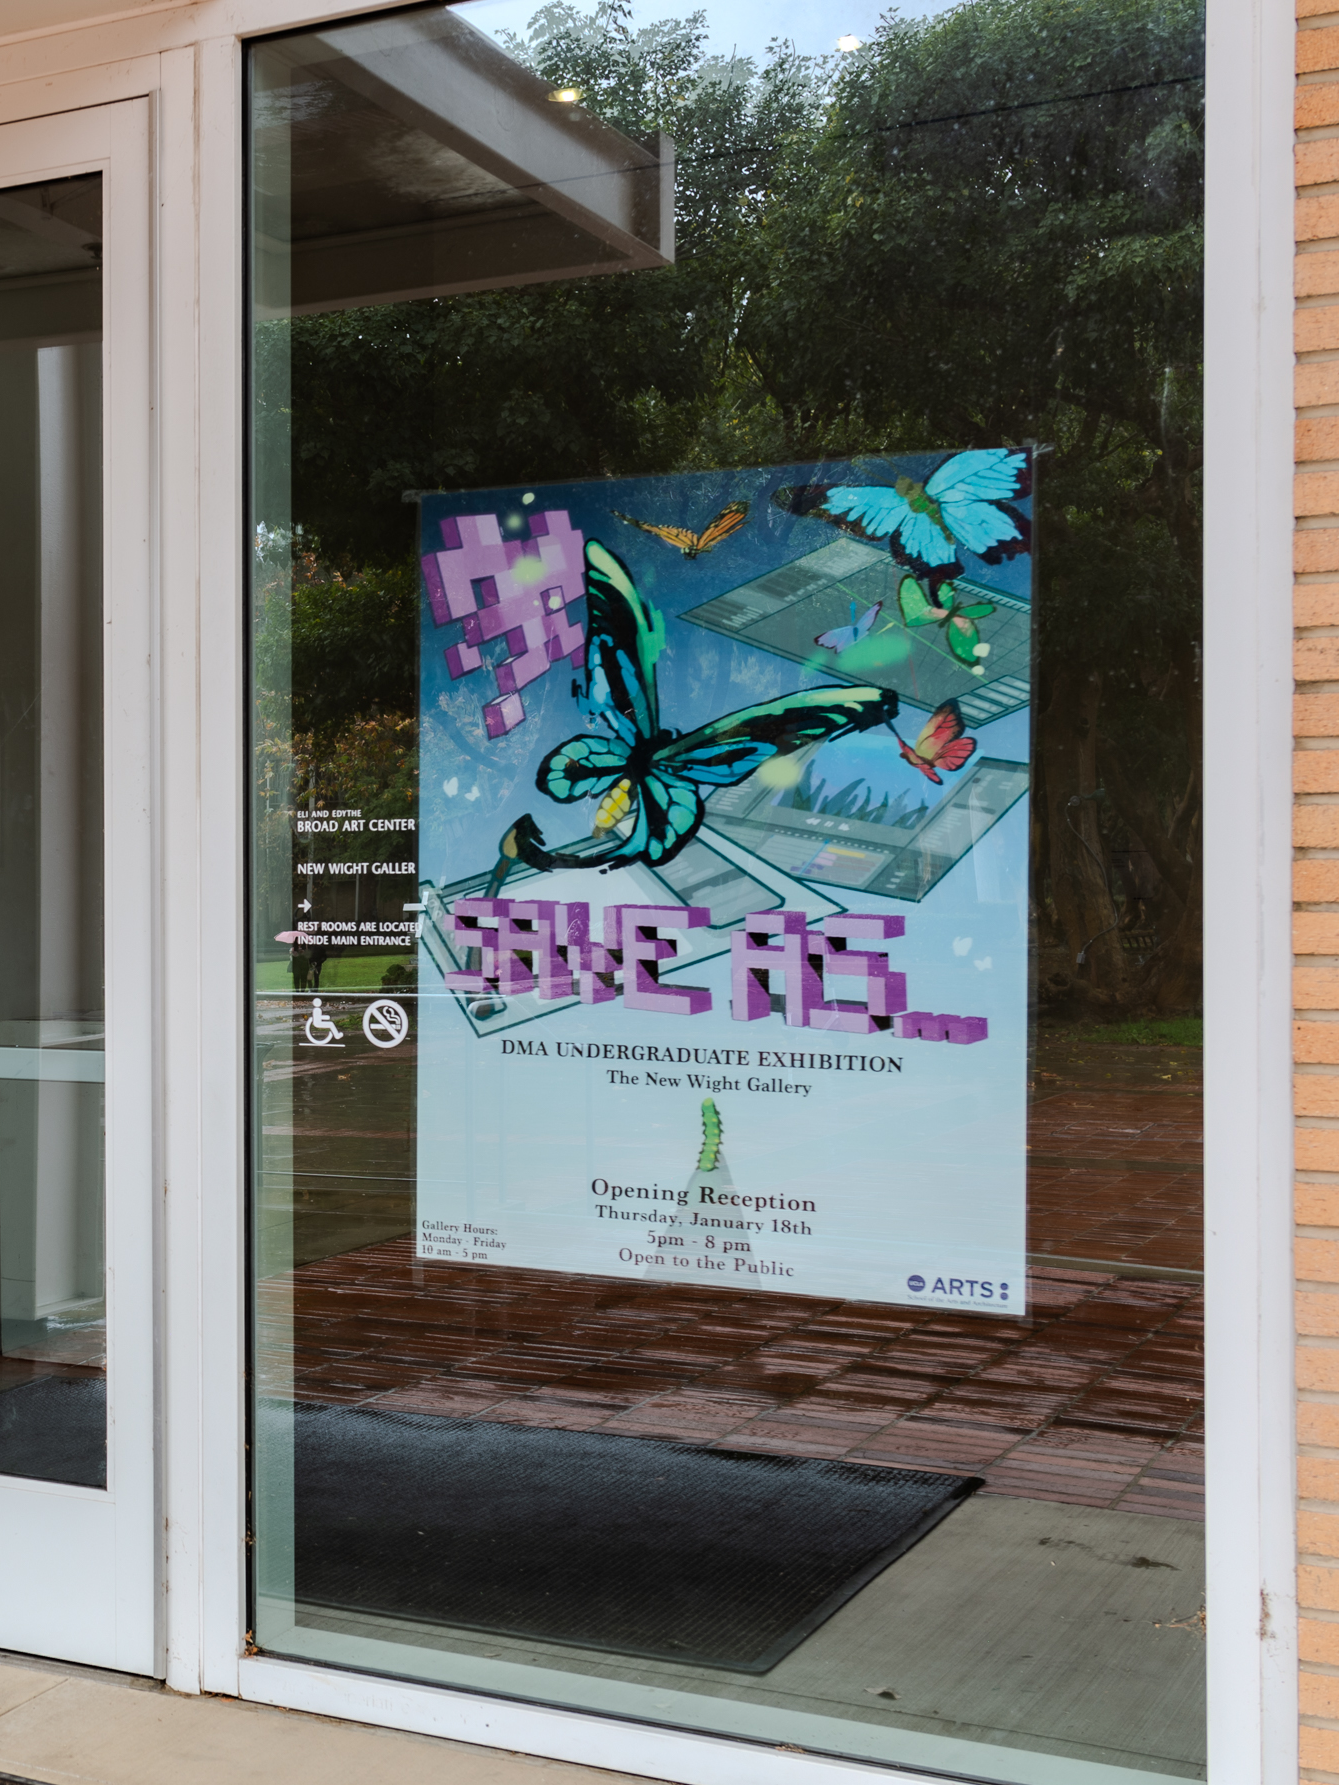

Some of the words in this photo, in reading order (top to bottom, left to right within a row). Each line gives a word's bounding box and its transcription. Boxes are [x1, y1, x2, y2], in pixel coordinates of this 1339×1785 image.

[332, 809, 361, 818] EDYTHE
[297, 820, 338, 832] BROAD
[342, 820, 365, 831] ART
[369, 819, 415, 831] CENTER
[297, 863, 325, 874] NEW
[328, 862, 369, 874] WIGHT
[298, 922, 319, 931] REST
[321, 921, 357, 932] ROOMS
[359, 922, 376, 931] ARE
[379, 922, 422, 932] LOCATED
[298, 935, 329, 945] INSIDE
[331, 936, 357, 945] MAIN
[361, 936, 411, 946] ENTRANCE
[500, 1038, 549, 1057] DMA
[556, 1041, 750, 1066] UNDERGRADUATE
[758, 1050, 904, 1074] EXHIBITION
[606, 1070, 639, 1086] The
[645, 1072, 681, 1088] New
[686, 1073, 741, 1094] Wight
[747, 1076, 812, 1097] Gallery
[591, 1178, 690, 1206] Opening
[698, 1186, 817, 1212] Reception
[422, 1220, 459, 1234] Gallery
[463, 1224, 498, 1235] Hours:
[595, 1204, 683, 1227] Thursday,
[690, 1212, 764, 1234] January
[771, 1219, 812, 1236] 18th
[422, 1232, 462, 1246] Monday
[473, 1236, 506, 1250] Friday
[646, 1230, 684, 1248] 5pm
[705, 1235, 715, 1249] 8
[723, 1240, 751, 1253] pm
[422, 1245, 433, 1254] 10
[462, 1248, 468, 1257] 5
[472, 1252, 488, 1260] pm
[618, 1248, 665, 1266] Open
[672, 1254, 689, 1267] to
[696, 1256, 726, 1270] the
[734, 1258, 795, 1277] Public
